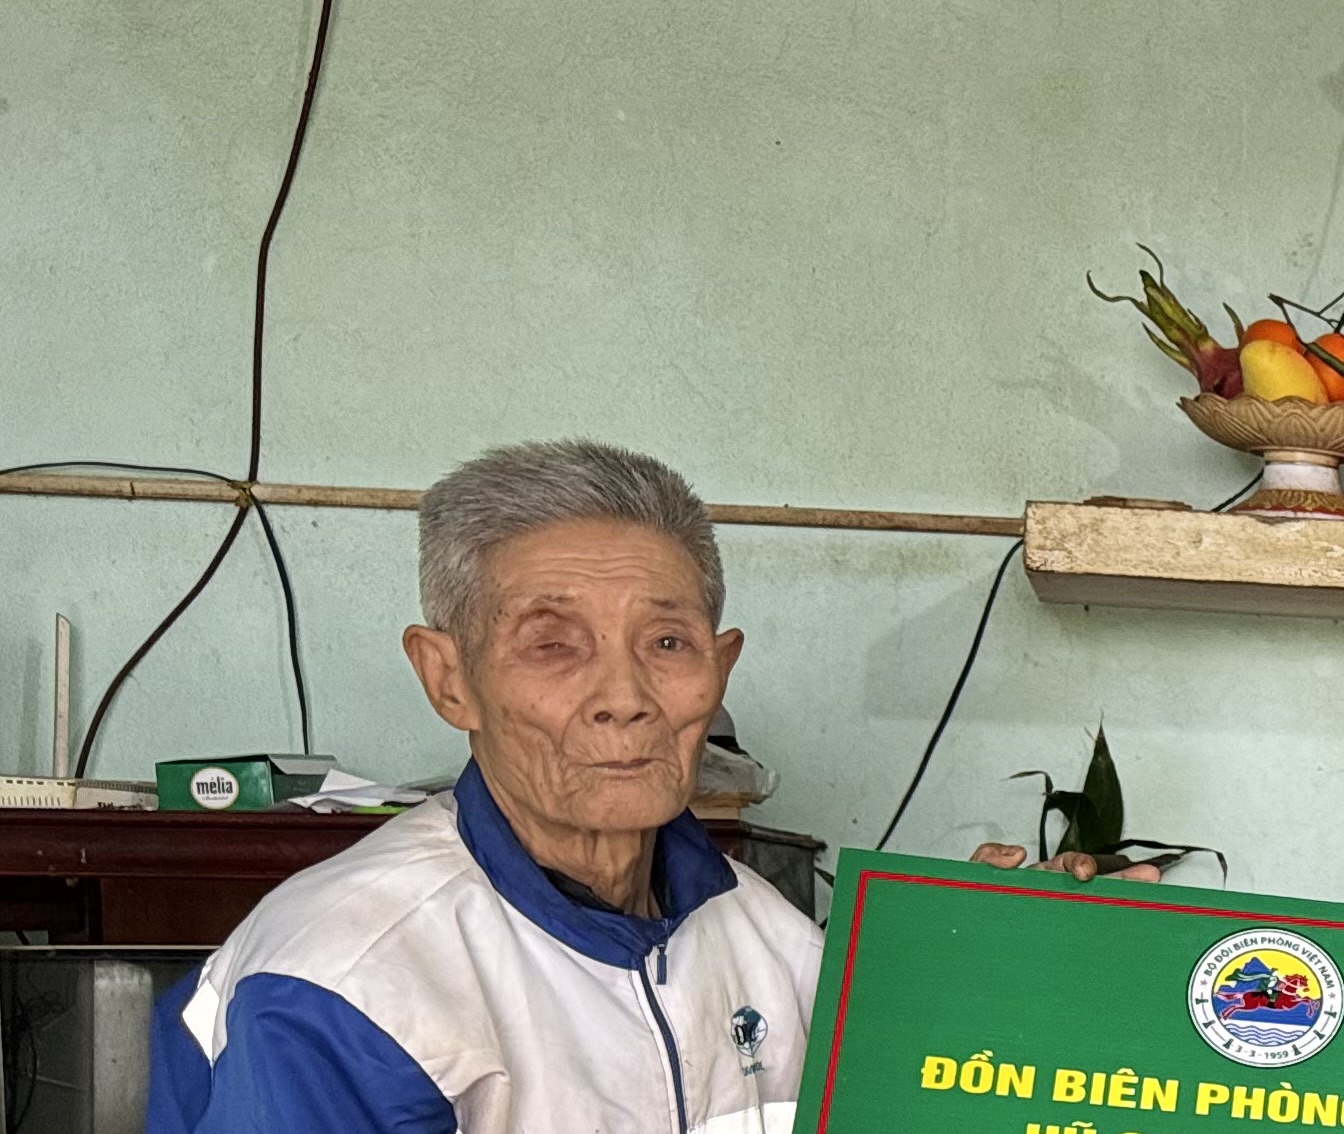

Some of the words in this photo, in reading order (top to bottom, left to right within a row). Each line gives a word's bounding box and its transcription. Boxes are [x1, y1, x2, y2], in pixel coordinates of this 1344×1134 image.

[1204, 962, 1217, 978] BỘ
[1217, 947, 1232, 964] ĐỘI
[1233, 936, 1259, 950] BIÊN
[1261, 936, 1300, 952] PHÒNG
[1301, 947, 1322, 966] VIỆT
[1320, 965, 1336, 989] NAM
[921, 1051, 1036, 1099] ĐỒN
[1052, 1067, 1179, 1112] BIÊN
